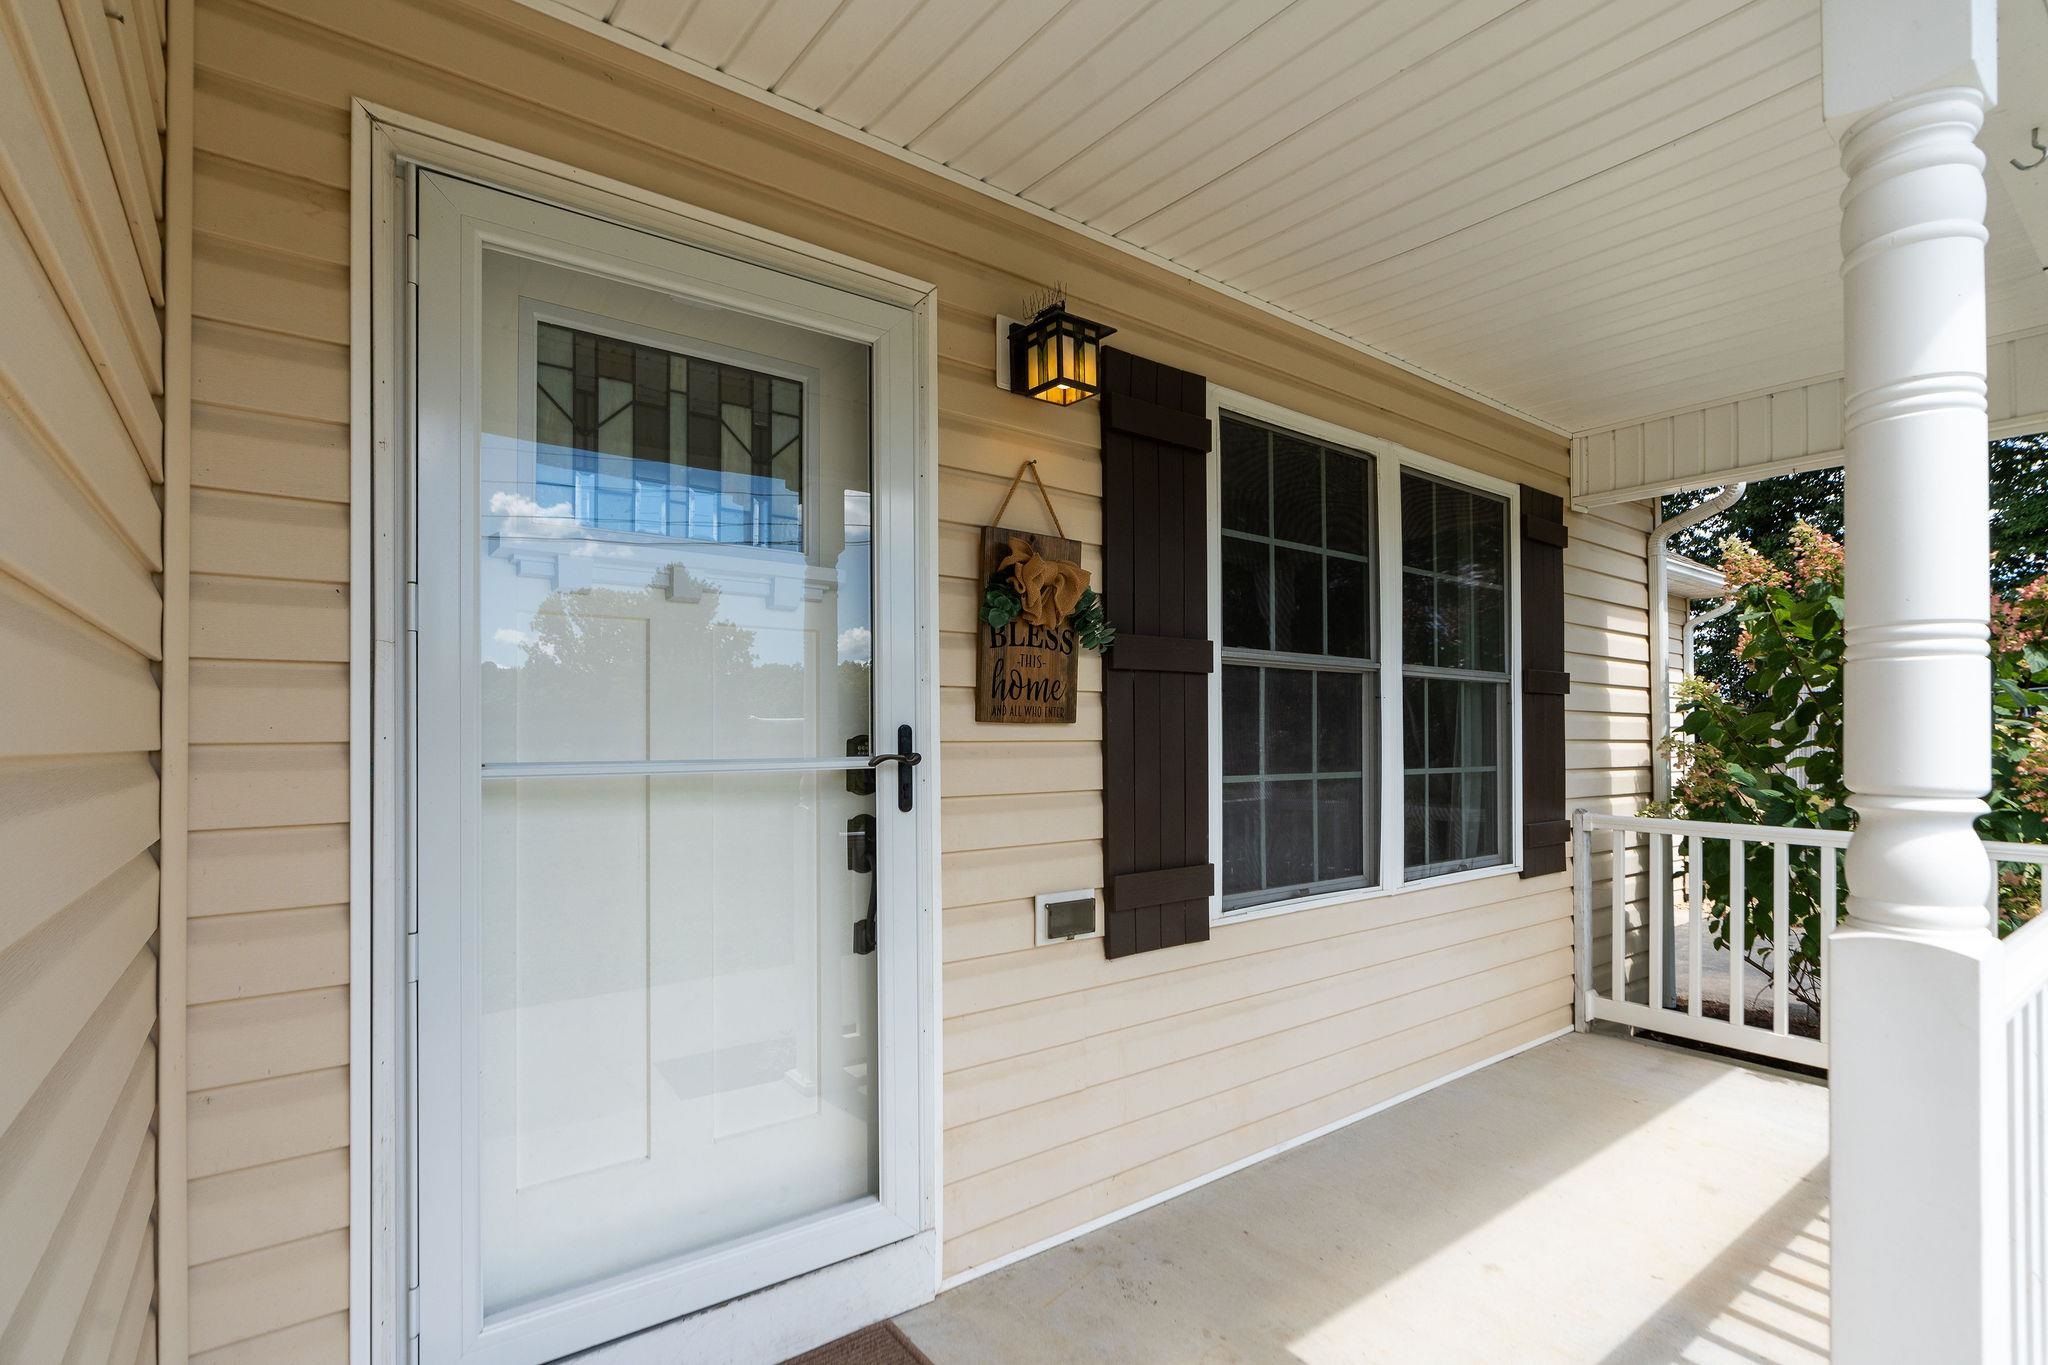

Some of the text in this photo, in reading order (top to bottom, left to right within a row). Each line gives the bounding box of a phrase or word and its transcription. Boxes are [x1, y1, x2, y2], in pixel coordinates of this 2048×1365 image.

[990, 621, 1075, 655] BLESS
[992, 658, 1067, 703] home
[991, 704, 1065, 719] AND ALL WHO ENTER
